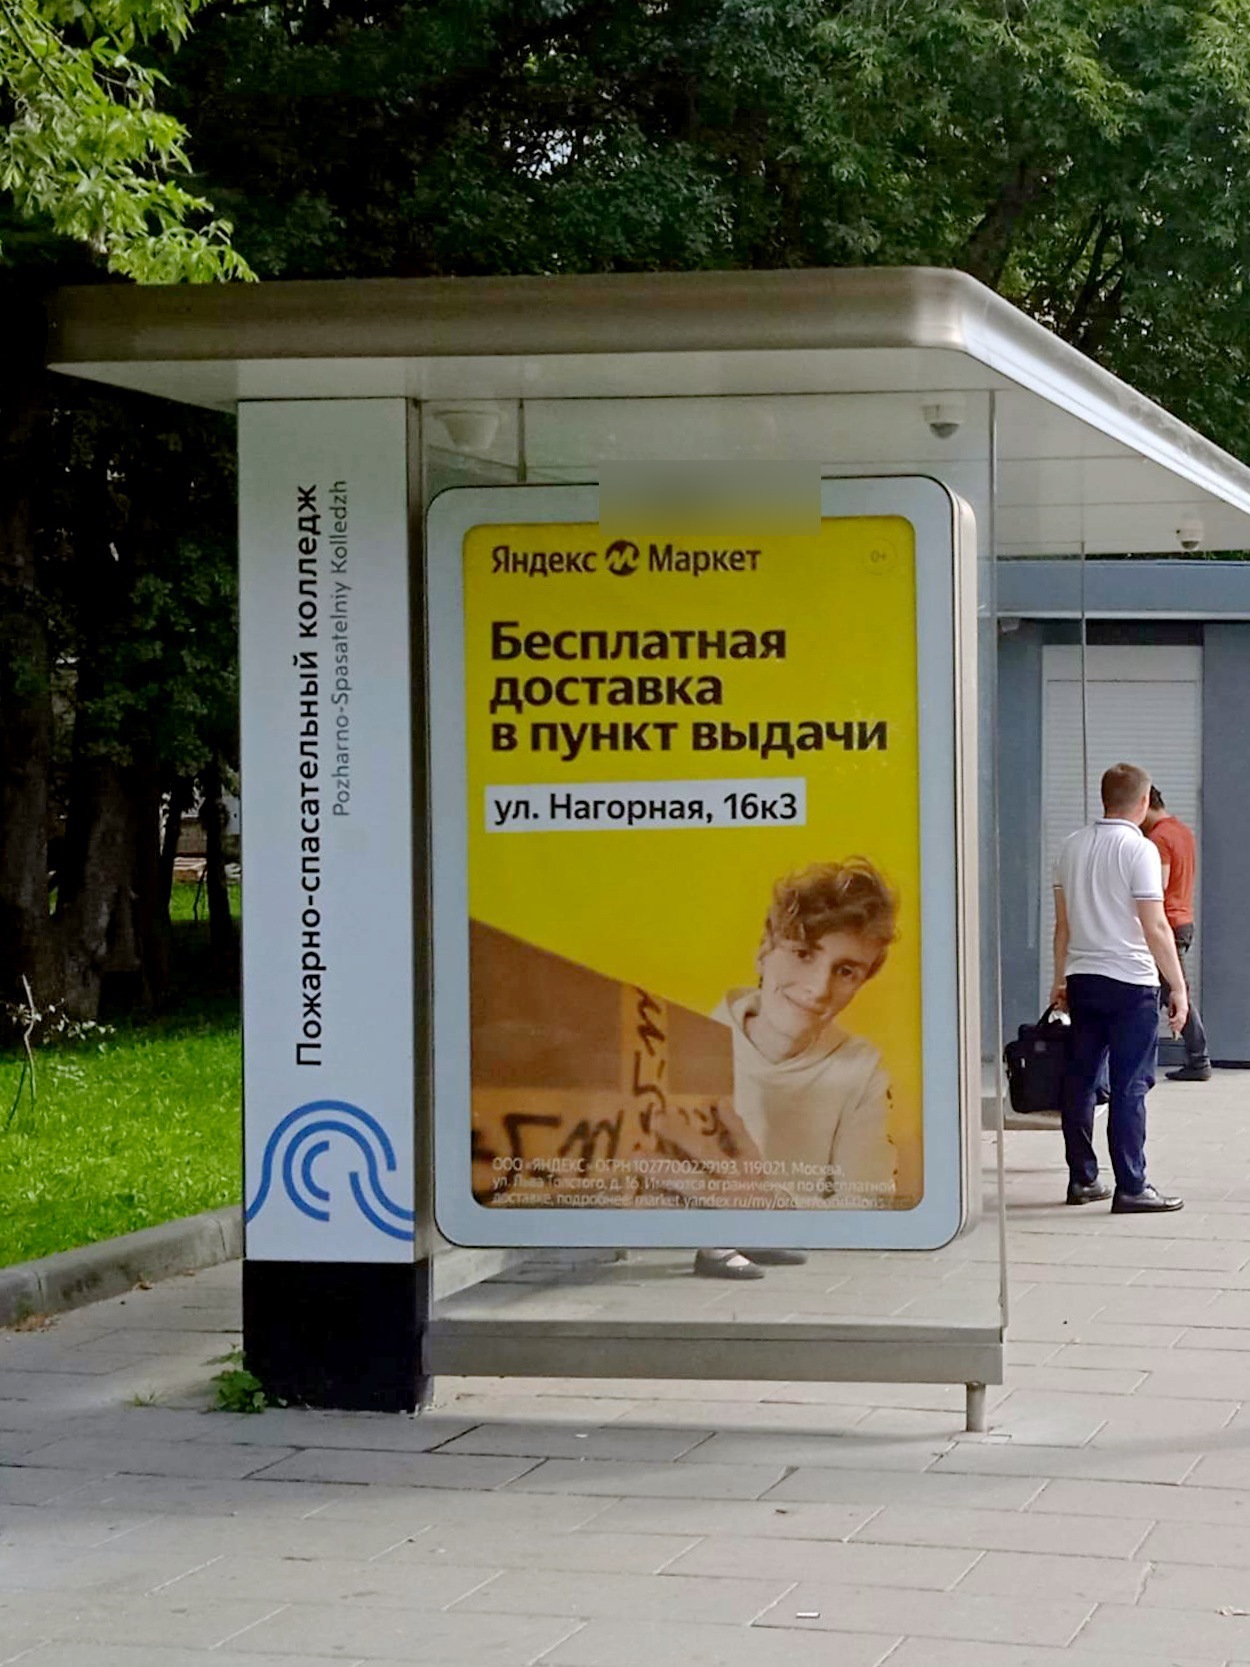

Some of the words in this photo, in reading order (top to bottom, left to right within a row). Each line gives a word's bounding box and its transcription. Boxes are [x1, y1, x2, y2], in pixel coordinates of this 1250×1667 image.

[330, 480, 347, 577] Kolledzh
[296, 485, 325, 638] колледж
[492, 545, 597, 577] Яндекс
[648, 544, 762, 576] Маркет
[491, 621, 787, 661] Бесплатная
[332, 580, 352, 817] Pozharno-Spasatelniy
[490, 676, 723, 714] доставка
[491, 723, 518, 751] в
[531, 722, 678, 760] пункт
[692, 720, 888, 759] выдачи
[494, 797, 539, 825] ул.
[550, 793, 714, 825] Нагорная,
[724, 792, 797, 821] 16к3
[293, 650, 327, 1066] Пожарно-спасательный
[492, 1156, 523, 1171] ООО
[596, 1158, 631, 1173] ОГРН
[797, 1181, 814, 1193] по
